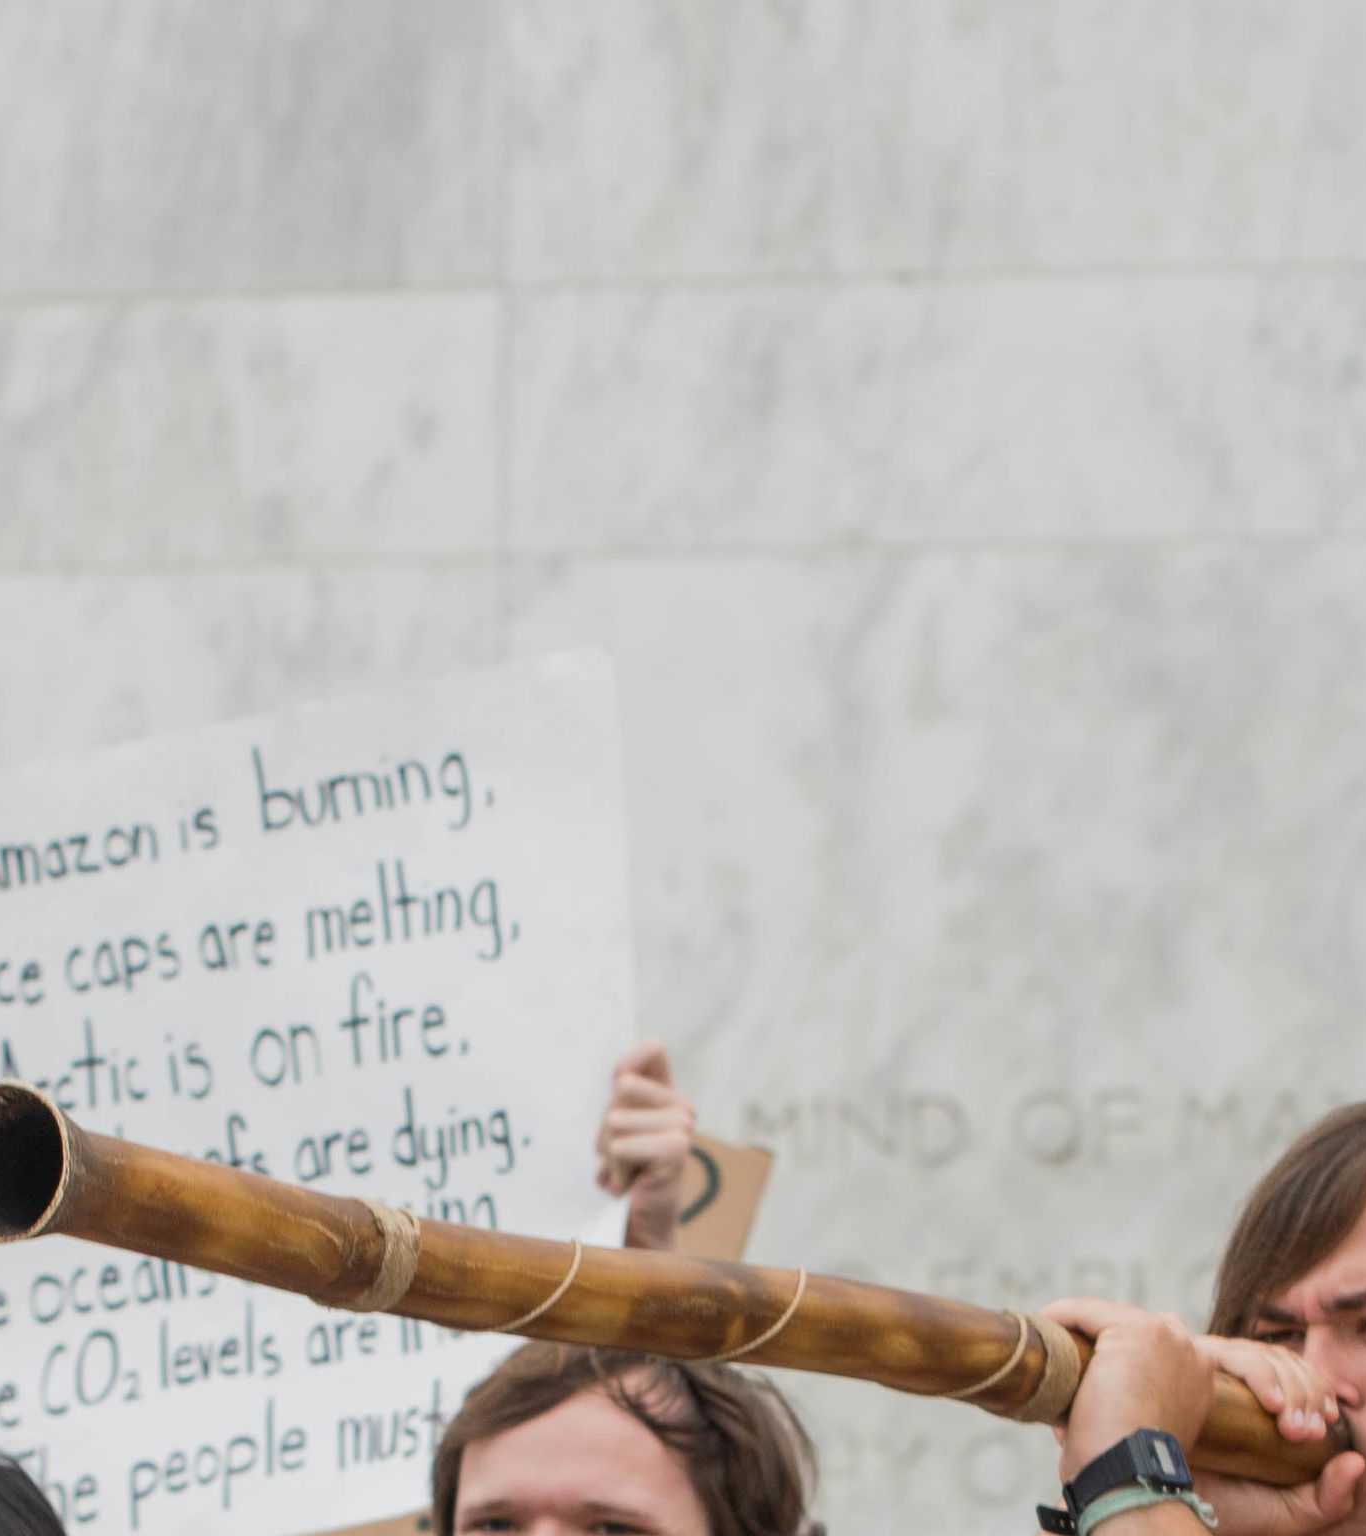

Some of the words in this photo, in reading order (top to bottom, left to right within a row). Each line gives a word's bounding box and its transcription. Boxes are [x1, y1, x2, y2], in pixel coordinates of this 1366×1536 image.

[178, 798, 219, 852] is
[252, 746, 495, 832] burning,
[65, 932, 181, 992] caps
[200, 920, 275, 970] are
[307, 859, 520, 961] melting,
[166, 1034, 213, 1099] is
[251, 1024, 322, 1087] on
[340, 971, 469, 1067] fire.
[295, 1128, 373, 1182] are
[394, 1086, 532, 1190] dying.
[741, 1086, 975, 1170] MIND
[1010, 1086, 1149, 1168] OF
[160, 1299, 282, 1388] levels
[307, 1316, 379, 1366] are
[130, 1397, 307, 1530] people
[338, 1379, 446, 1471] must
